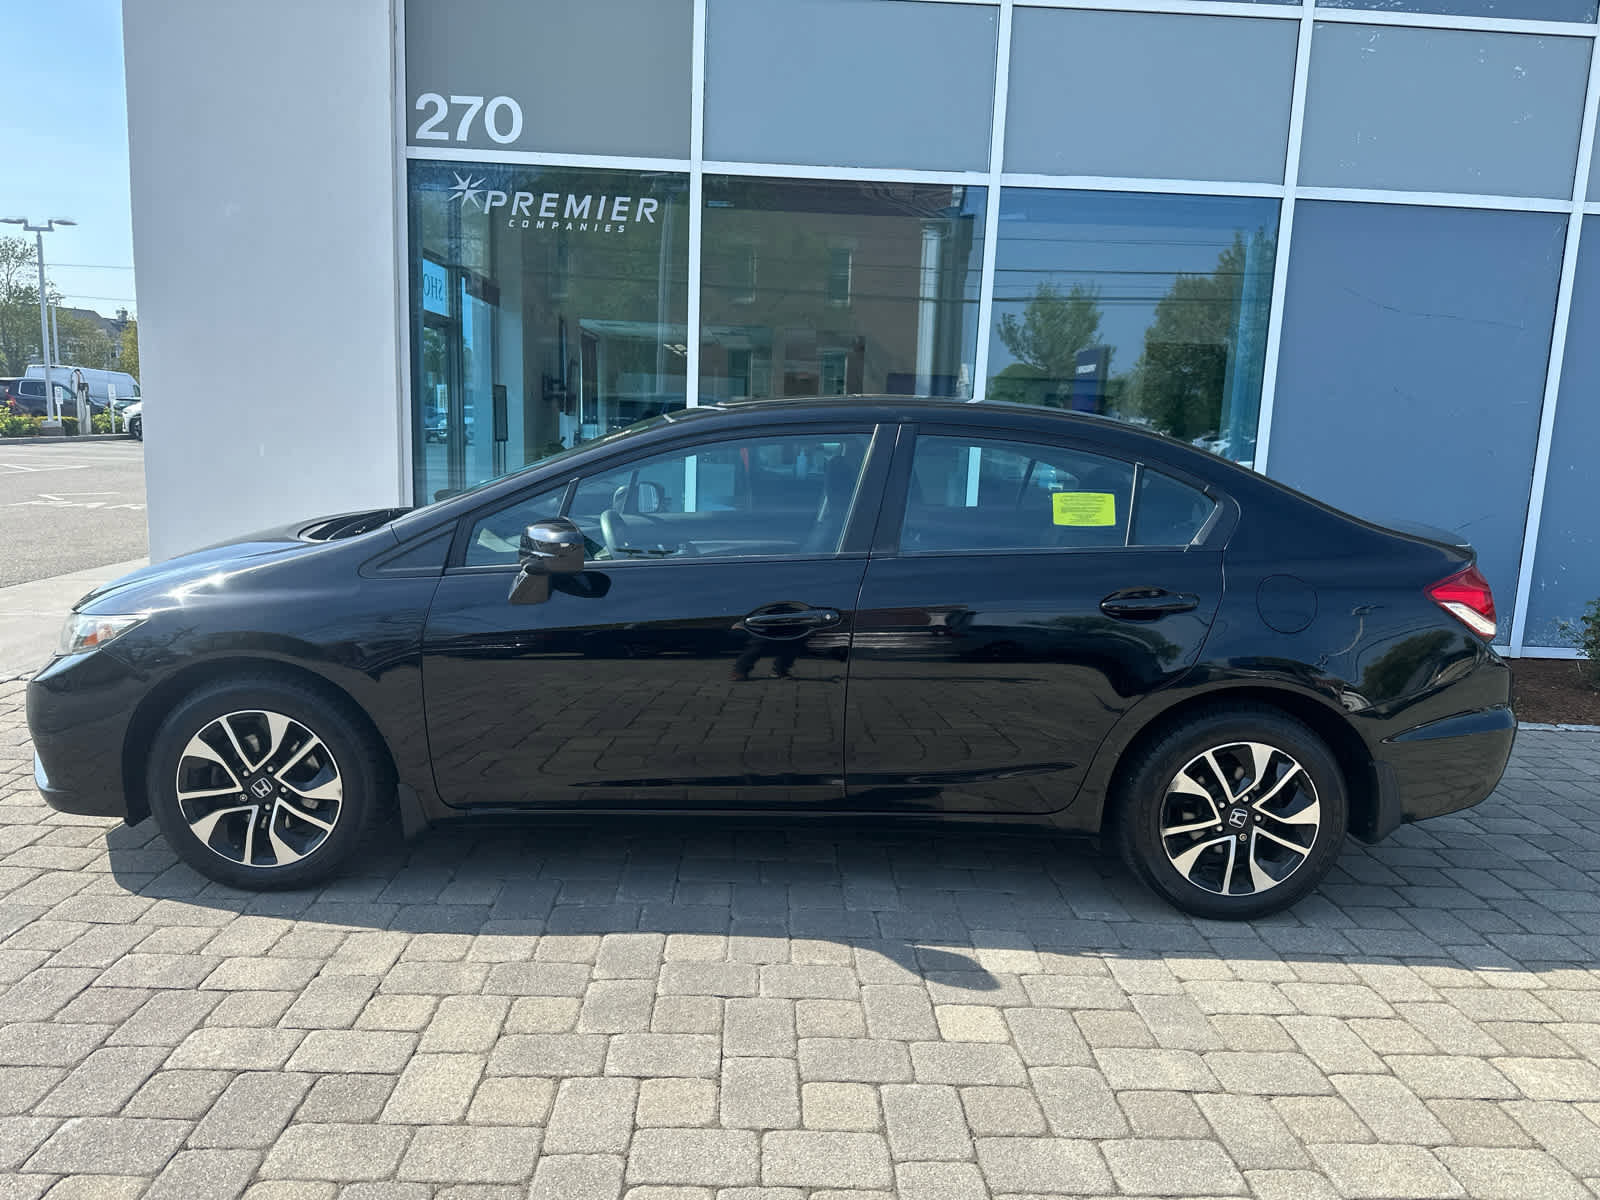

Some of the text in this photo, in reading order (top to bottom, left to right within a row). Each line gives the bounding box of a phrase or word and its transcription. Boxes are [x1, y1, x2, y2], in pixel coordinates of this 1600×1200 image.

[415, 92, 523, 144] 270
[483, 190, 659, 223] PREMIER
[508, 219, 625, 233] COMPANIES
